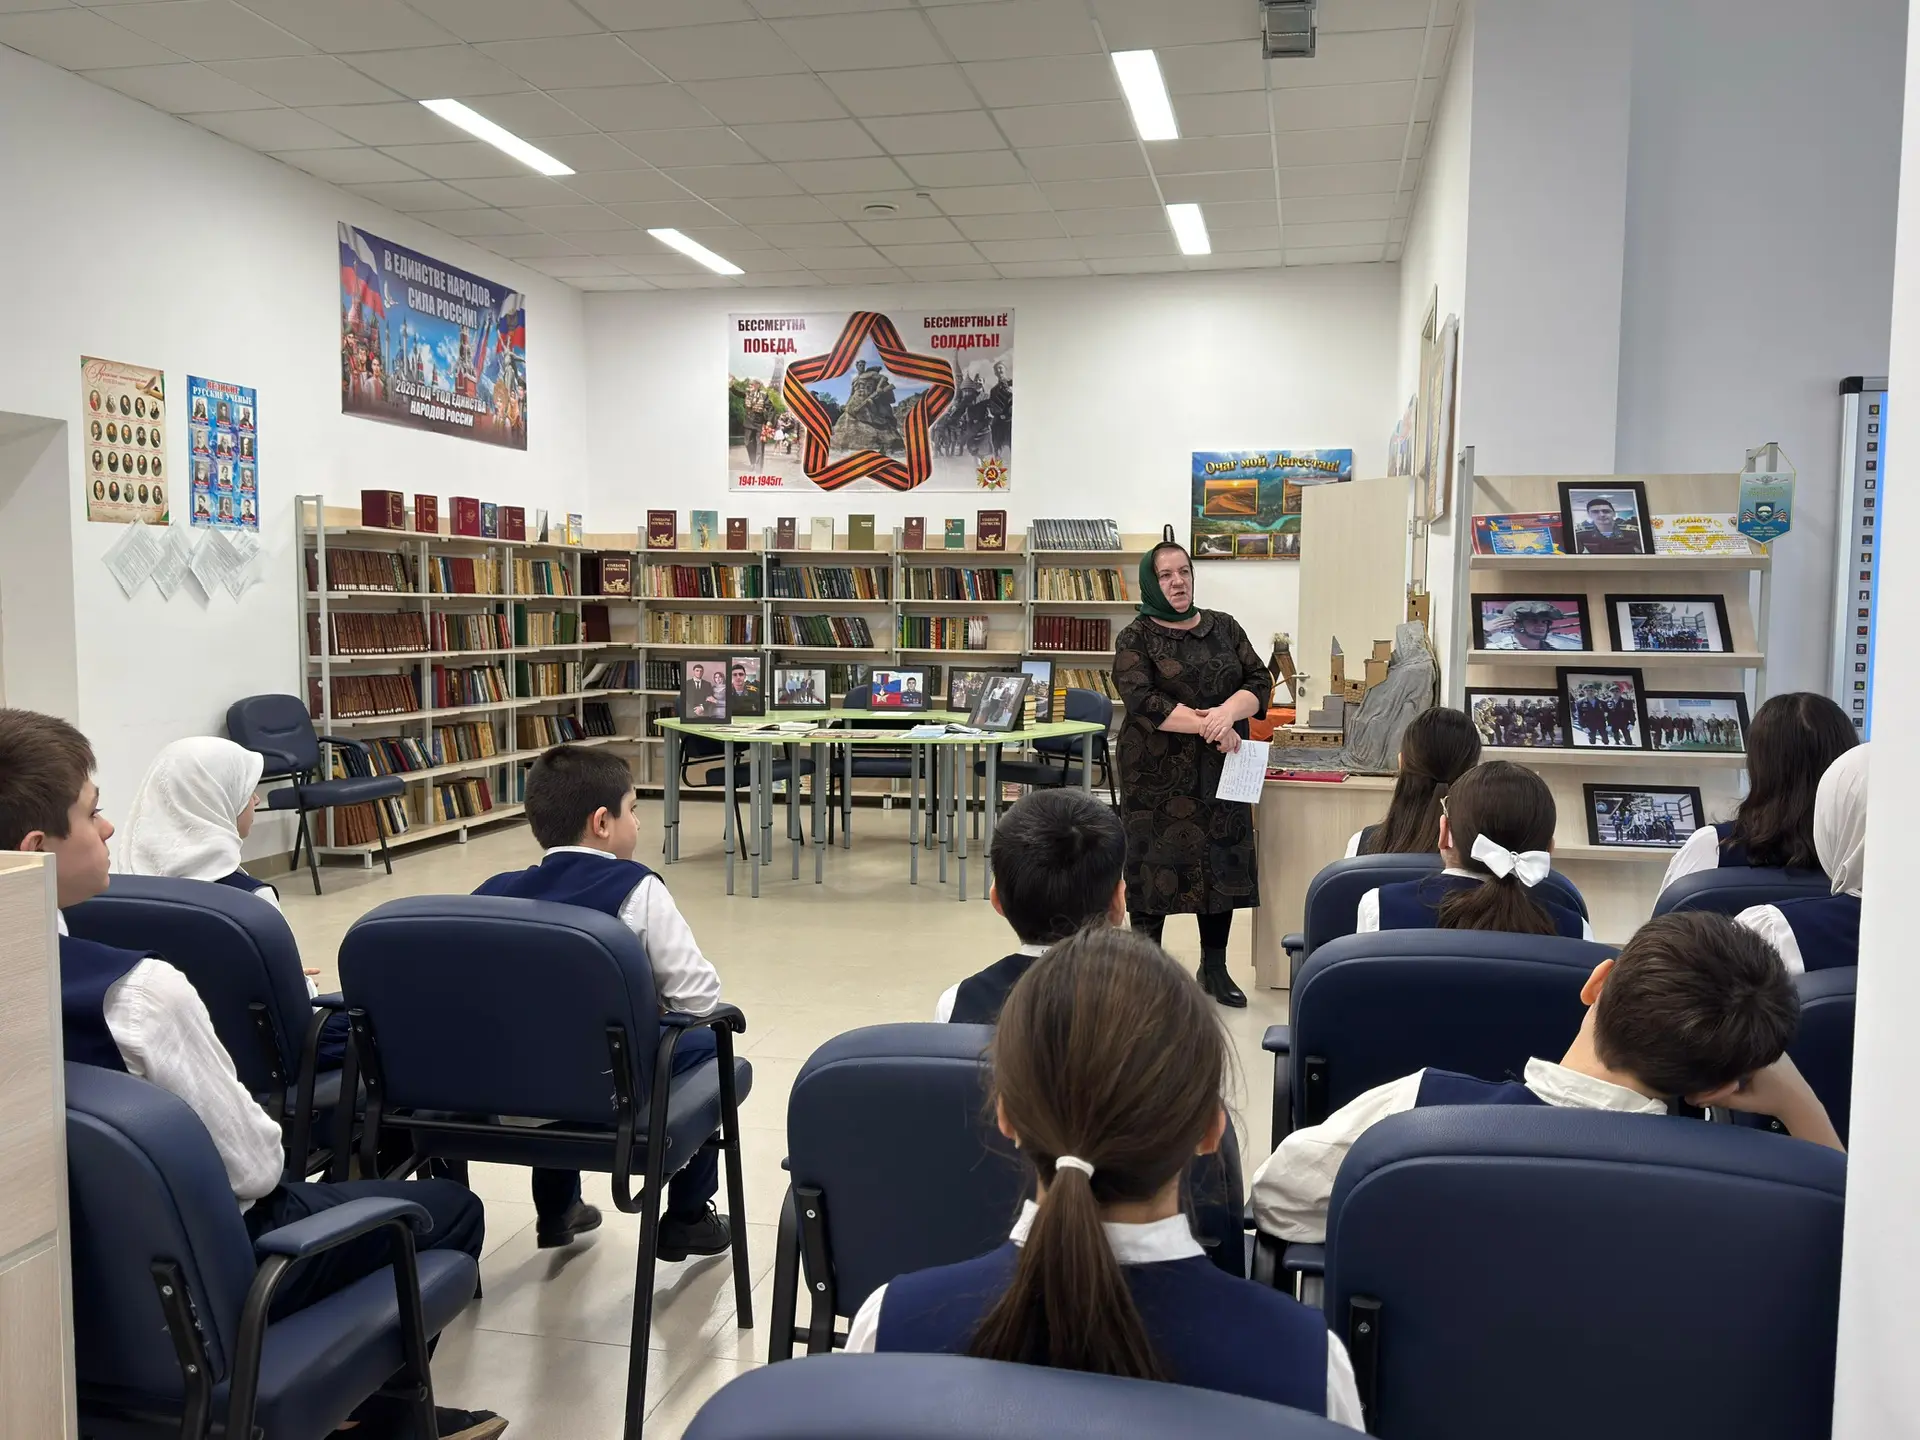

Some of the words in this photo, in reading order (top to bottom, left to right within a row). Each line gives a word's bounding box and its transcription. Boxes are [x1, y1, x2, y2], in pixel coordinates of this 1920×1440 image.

[384, 249, 392, 271] В
[394, 253, 446, 292] ЕДИНСТВЕ
[447, 273, 490, 307] НАРОДОВ
[408, 287, 435, 315] СИЛА
[437, 298, 477, 329] РОССИИ!
[738, 319, 806, 332] БЕССМЕРТНА
[924, 316, 995, 328] БЕССМЕРТНЫ
[997, 312, 1008, 327] ЕЁ
[744, 338, 797, 355] ПОБЕДА,
[931, 334, 1000, 351] СОЛДАТЫ!
[193, 386, 224, 400] РУССКИЕ
[395, 380, 416, 396] 2026
[416, 385, 431, 402] ГОД
[435, 390, 451, 406] ГОД
[451, 393, 487, 414] ЕДИНСТВА
[410, 401, 445, 420] НАРОДОВ
[446, 409, 474, 427] РОССИИ
[1205, 461, 1238, 474] Очаг
[1240, 456, 1269, 469] мой,
[1272, 454, 1340, 472] Дагестан!
[739, 475, 784, 486] 1941-1945гг.
